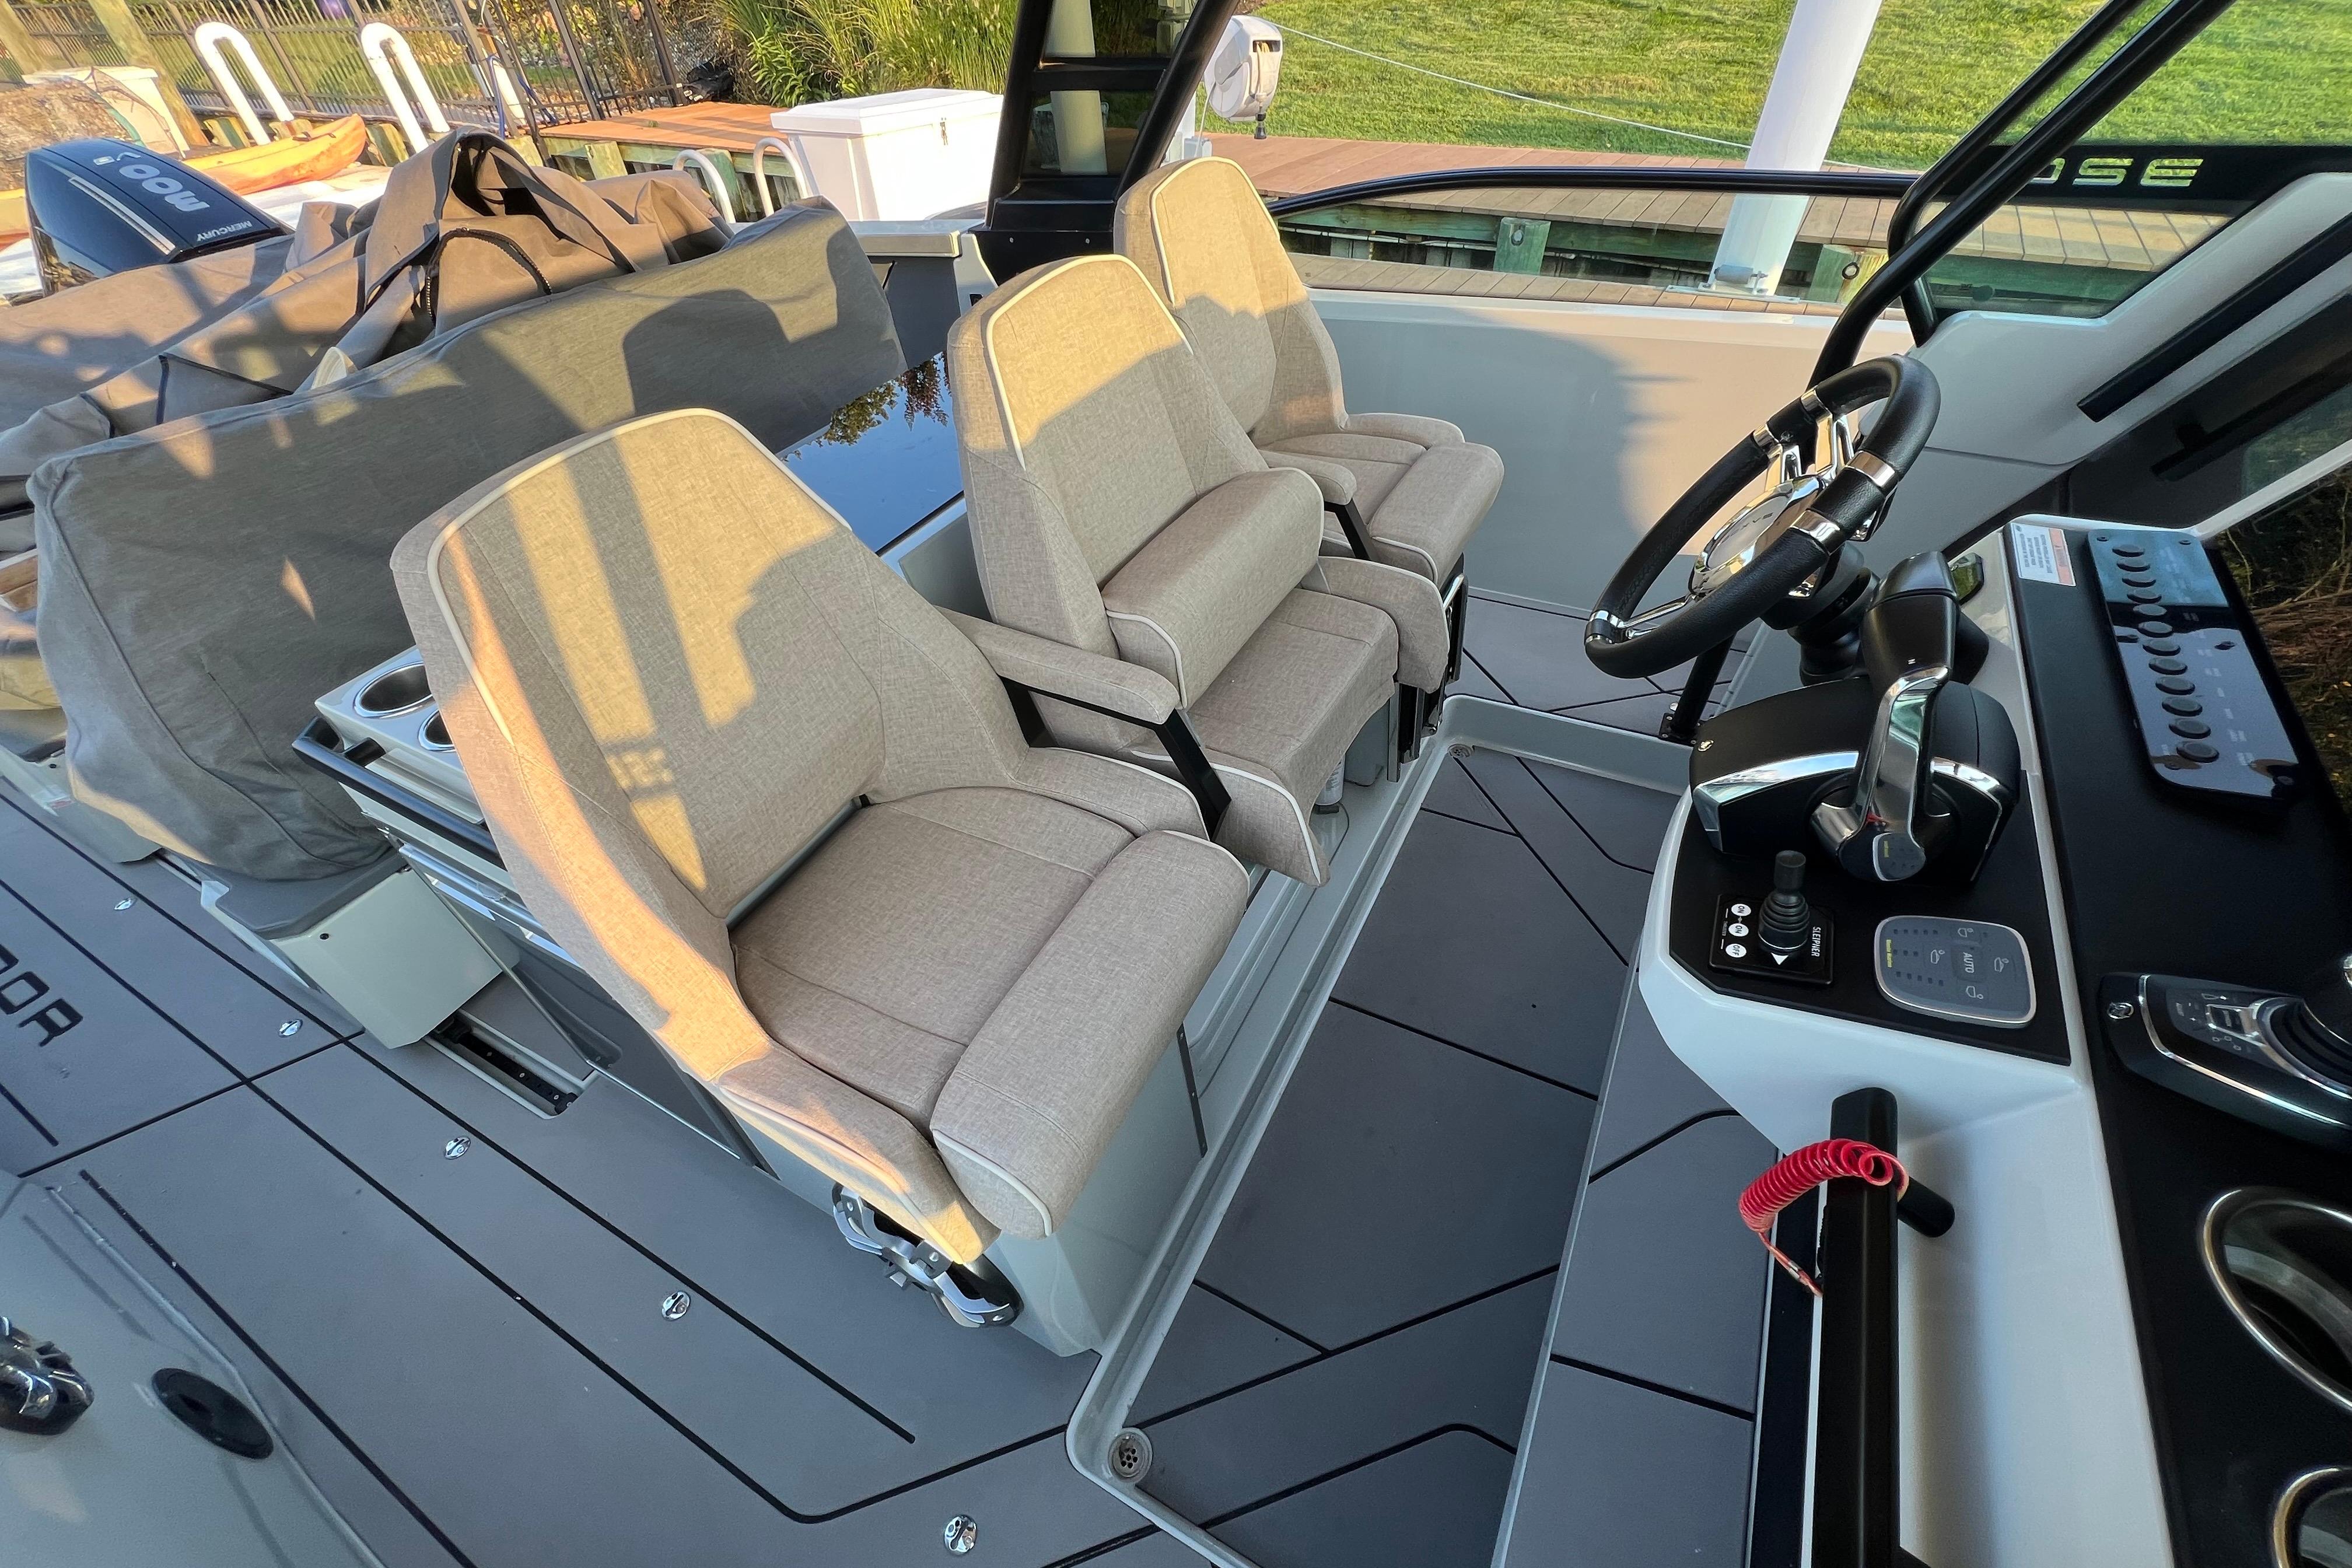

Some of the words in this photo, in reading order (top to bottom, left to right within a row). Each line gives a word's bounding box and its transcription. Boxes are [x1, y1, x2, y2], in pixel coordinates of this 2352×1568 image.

[119, 164, 211, 212] 300
[196, 220, 252, 242] MERCURY
[1737, 905, 1745, 914] ON
[1734, 925, 1743, 934] ON
[1812, 926, 1822, 957] SLEIPNER
[1962, 951, 1975, 974] AUTO
